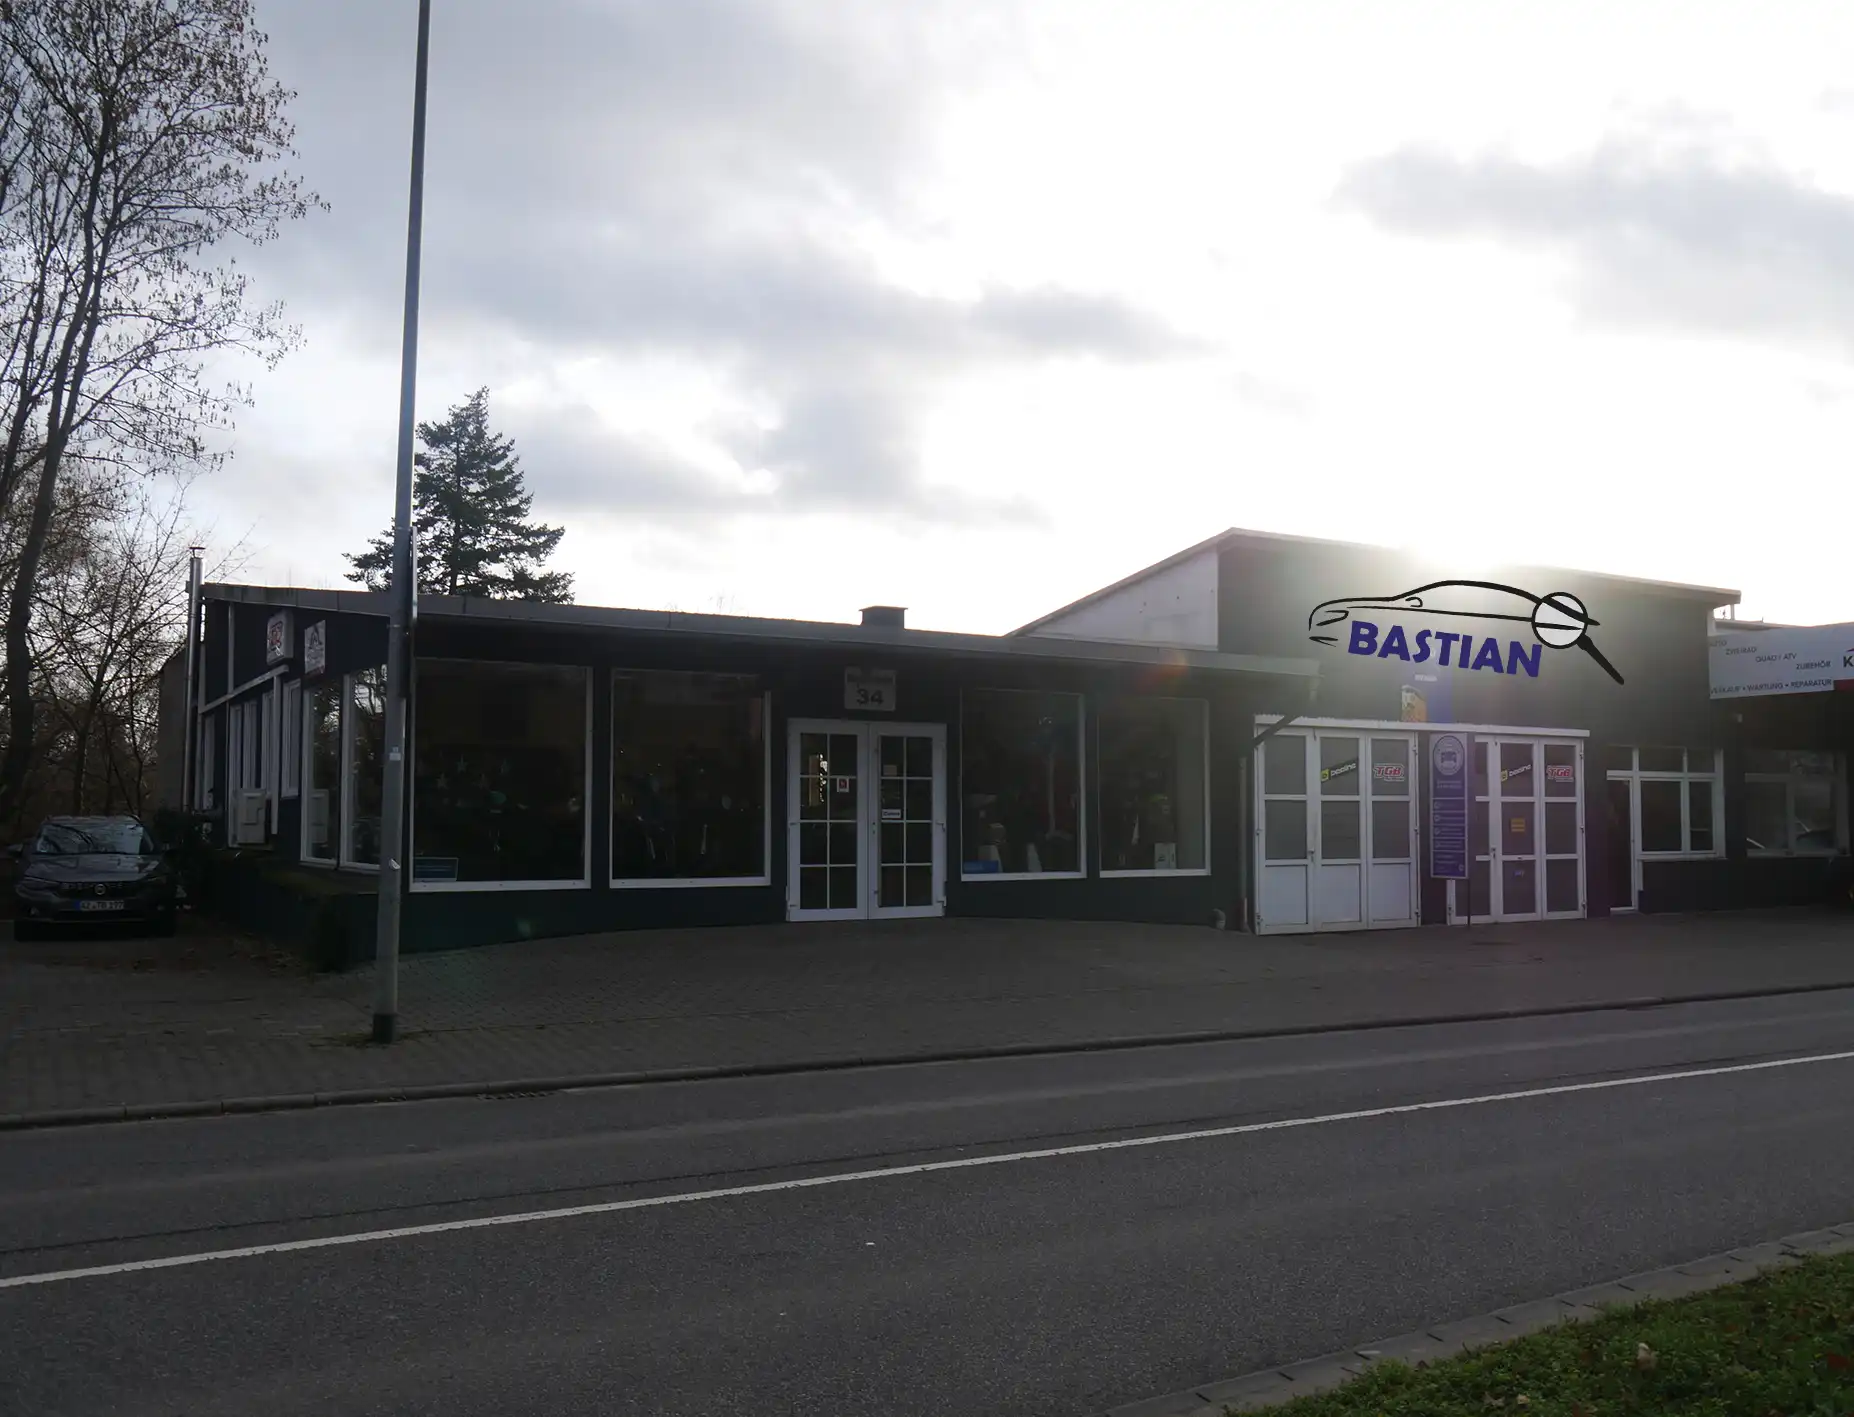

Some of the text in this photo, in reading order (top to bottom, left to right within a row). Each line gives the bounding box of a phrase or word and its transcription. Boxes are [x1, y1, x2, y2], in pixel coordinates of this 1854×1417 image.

[1710, 639, 1727, 647] UTO
[1755, 654, 1777, 662] QUAD
[1796, 660, 1832, 670] ZUBEHÖR
[1746, 682, 1783, 692] WARTUNG
[1790, 679, 1832, 688] REPARATUR
[856, 688, 884, 705] 34
